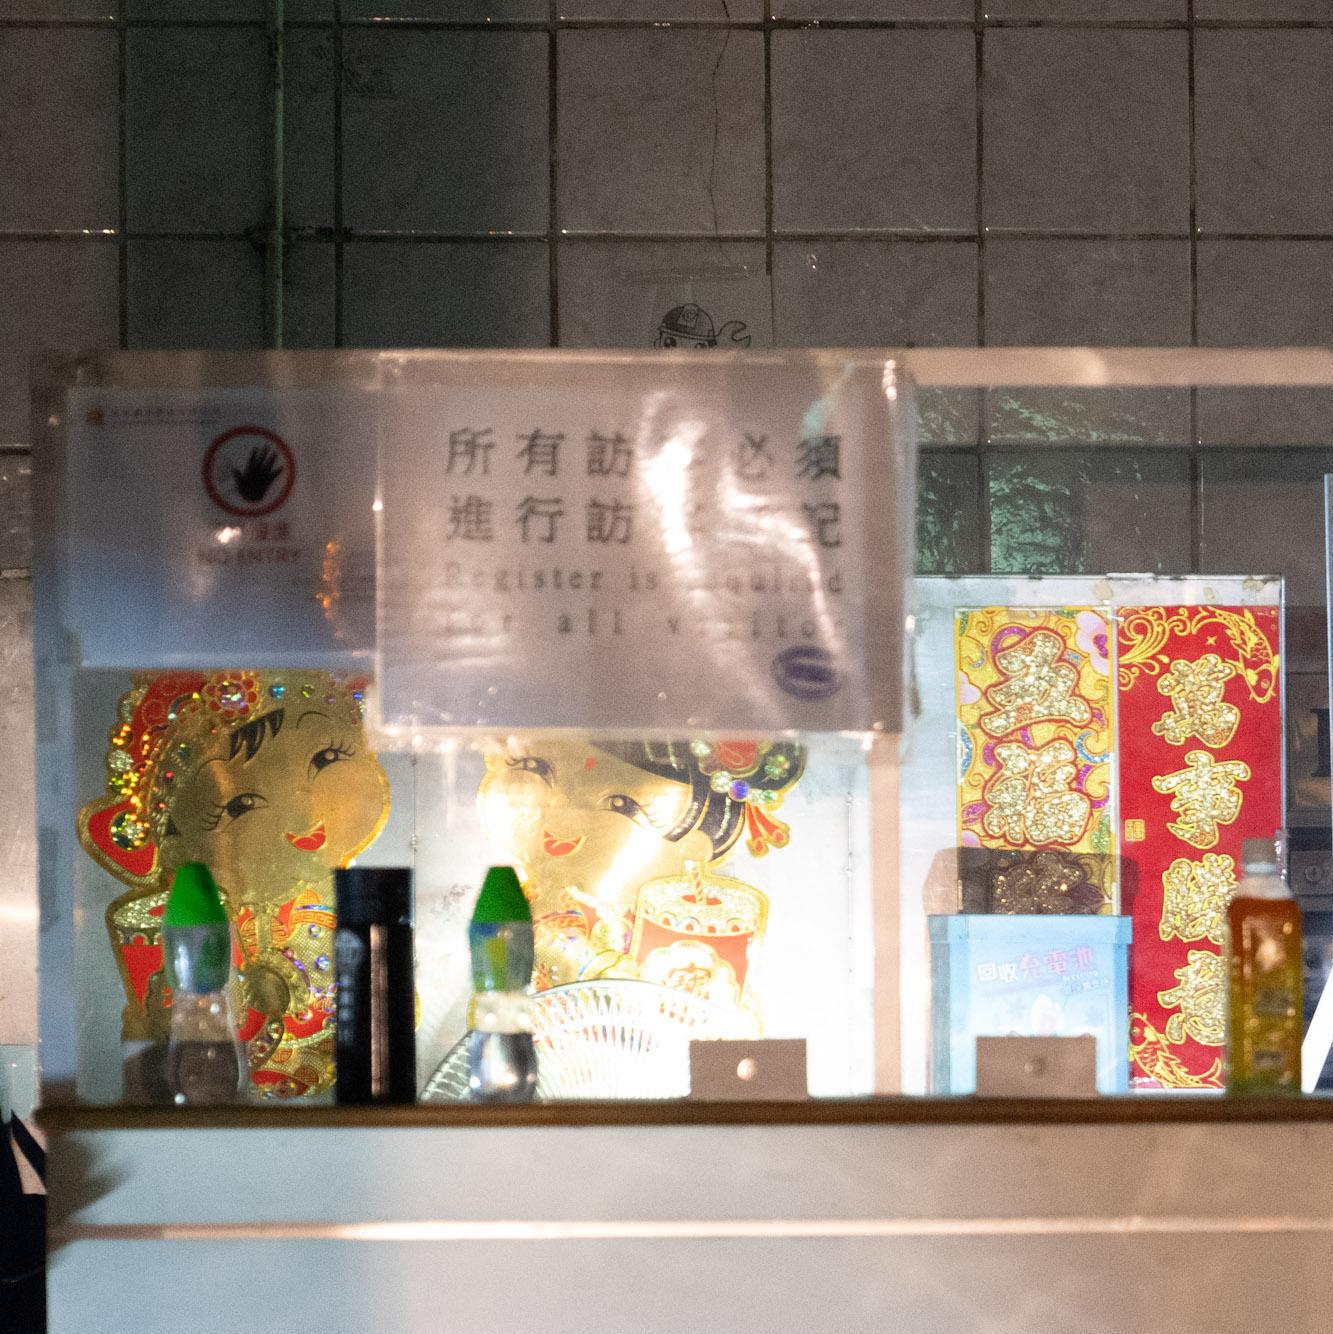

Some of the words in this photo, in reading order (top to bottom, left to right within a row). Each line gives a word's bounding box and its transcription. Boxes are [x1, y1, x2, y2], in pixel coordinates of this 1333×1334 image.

[445, 428, 842, 481] 所有訪必須
[446, 494, 842, 548] 進行訪記
